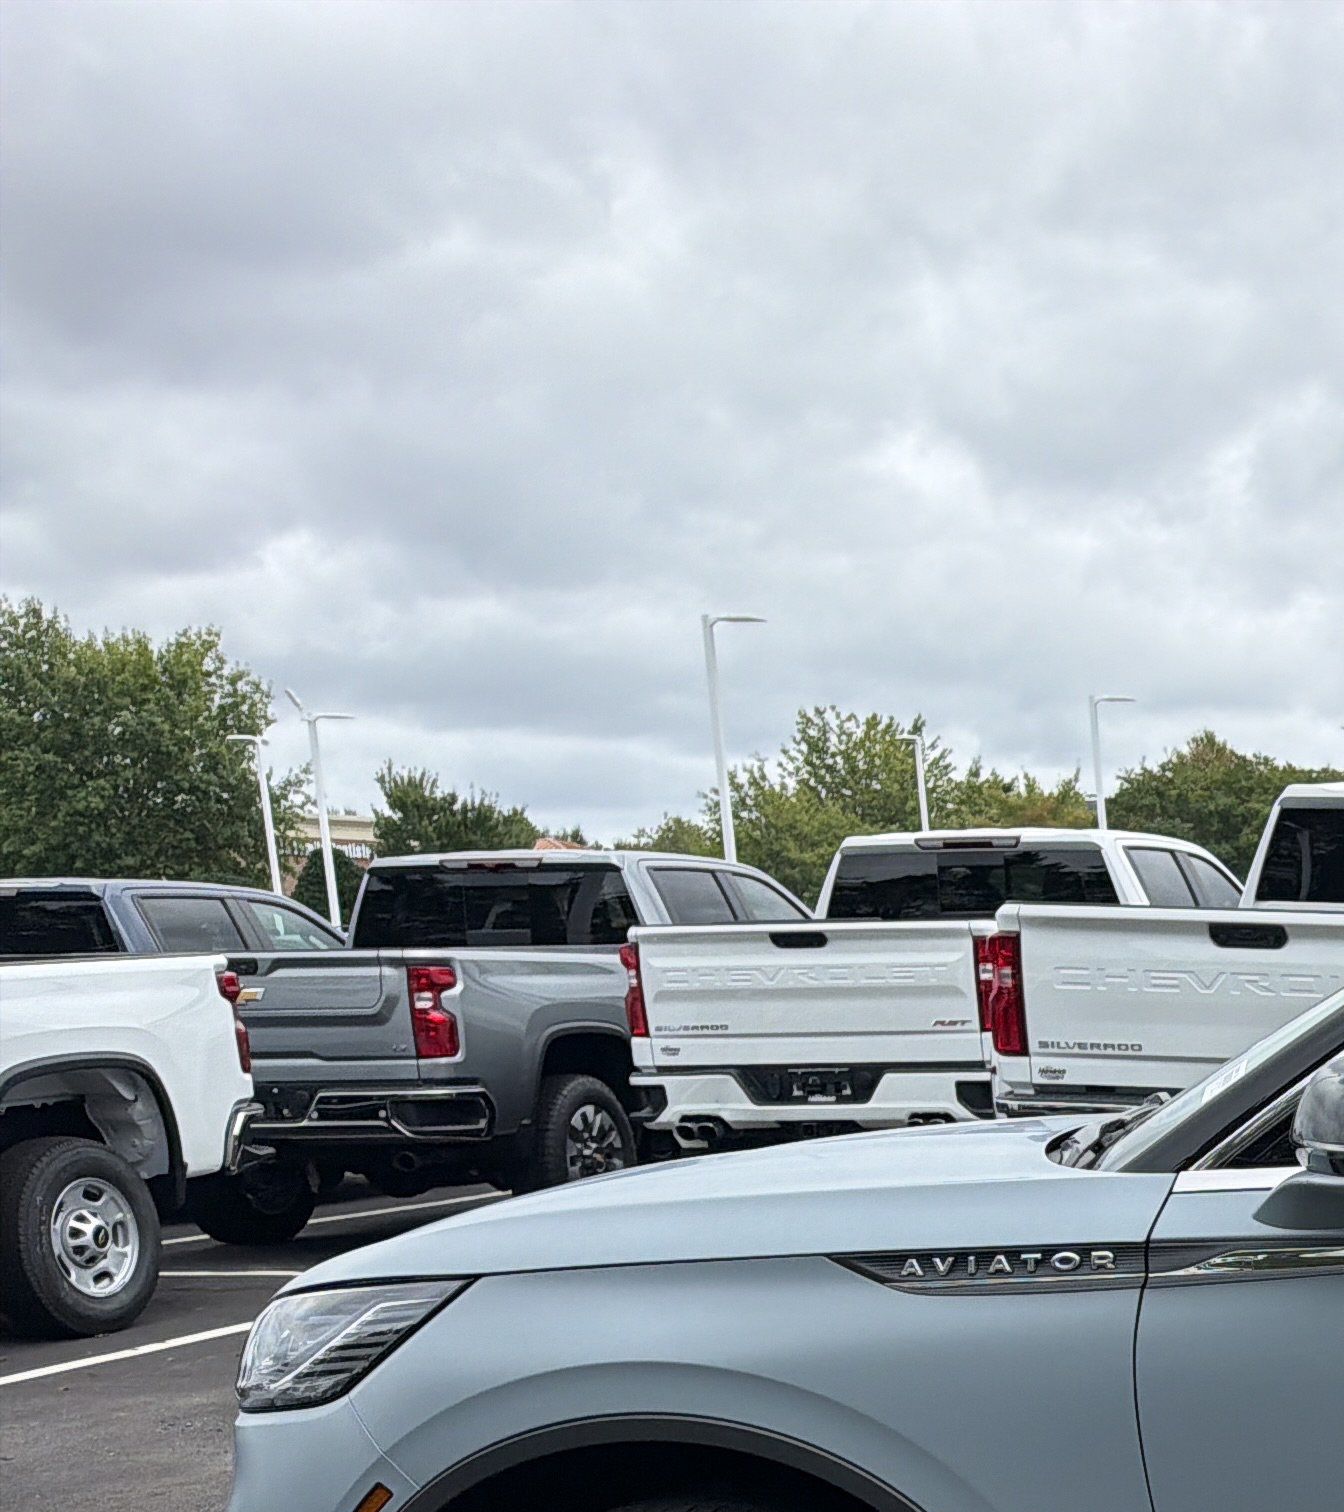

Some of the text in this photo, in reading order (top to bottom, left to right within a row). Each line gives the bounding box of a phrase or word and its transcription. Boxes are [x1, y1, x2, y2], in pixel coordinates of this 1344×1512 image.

[662, 964, 948, 988] CHEVROLET
[1053, 965, 1340, 999] CHEVRO
[654, 1023, 729, 1032] SILVERADO
[1037, 1039, 1143, 1052] SILVERADO
[900, 1250, 1117, 1277] AVIATOR
